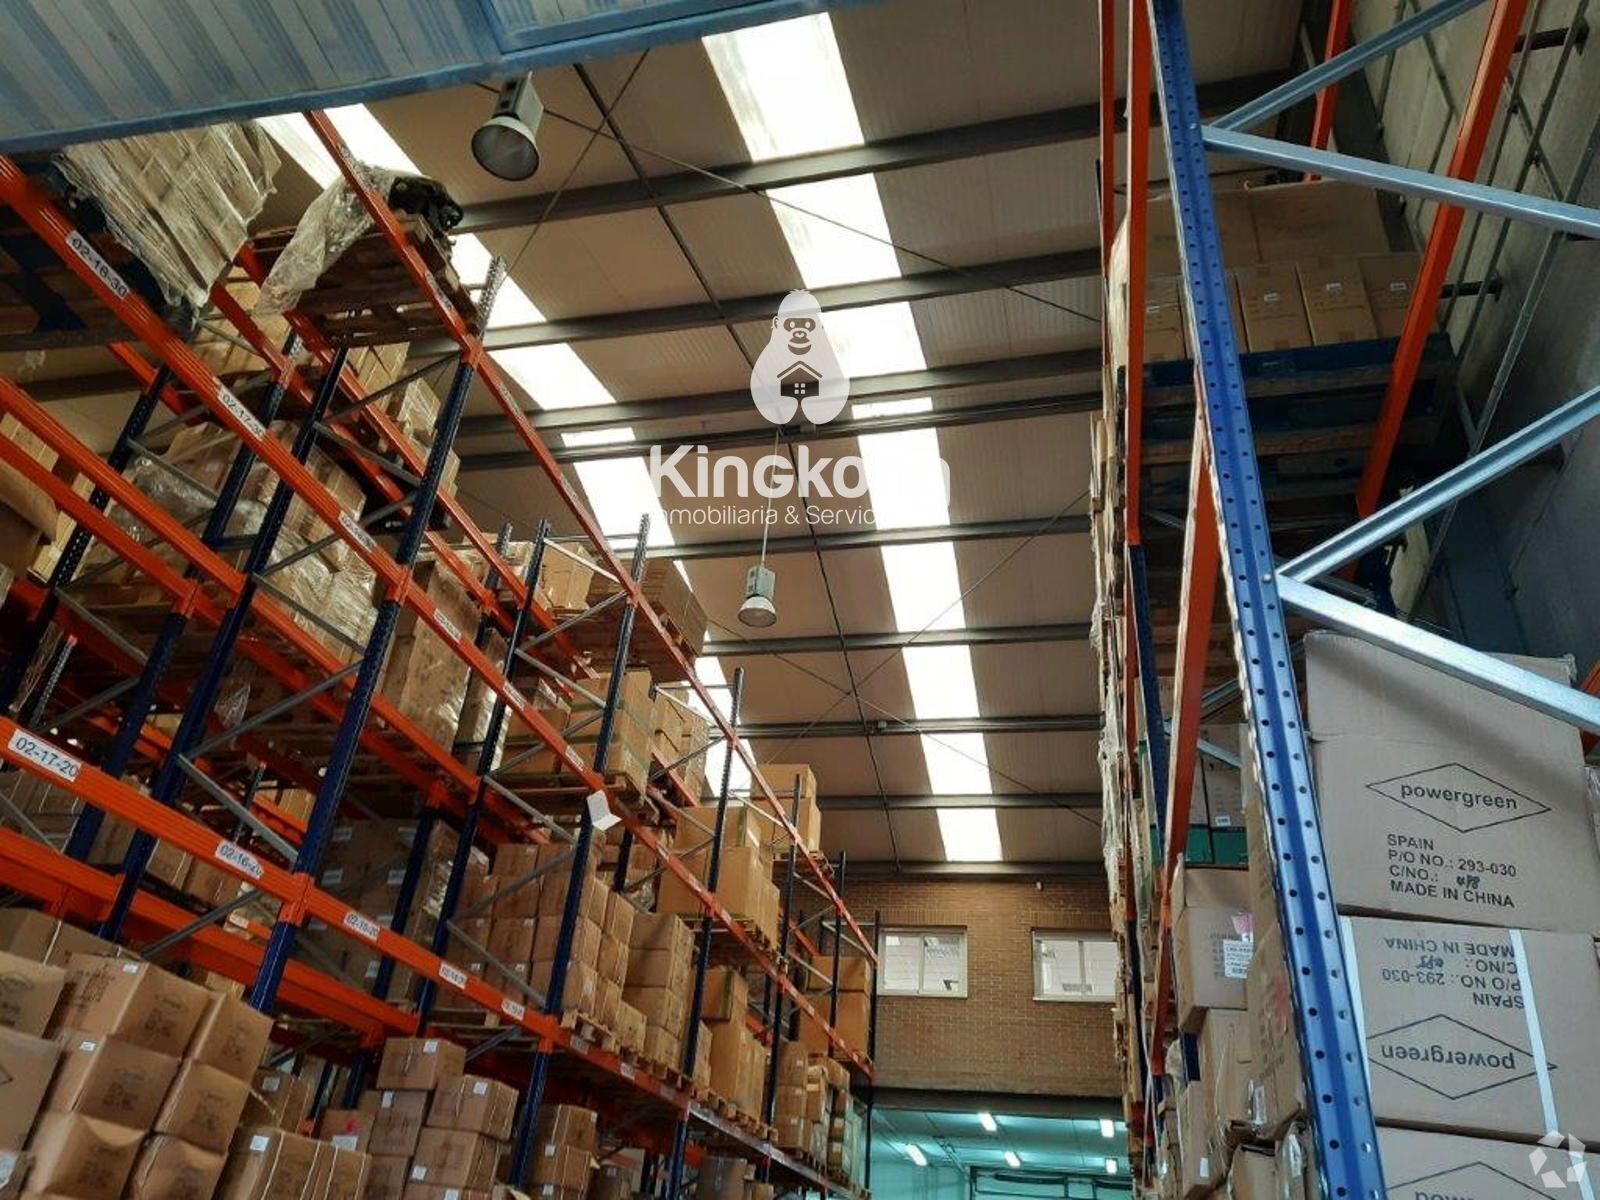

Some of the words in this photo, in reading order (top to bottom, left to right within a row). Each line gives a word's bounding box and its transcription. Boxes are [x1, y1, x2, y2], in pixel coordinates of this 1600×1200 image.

[15, 737, 80, 777] 02-17-20
[1401, 784, 1518, 810] powergreen
[1387, 833, 1435, 851] SPAIN
[1388, 848, 1416, 864] P/O
[1458, 858, 1517, 877] 293-030
[1390, 879, 1438, 898] MADE
[1443, 887, 1459, 901] IN
[1463, 890, 1515, 909] CHINA
[1383, 937, 1438, 952] CHINA
[1443, 941, 1460, 953] IN
[1464, 943, 1515, 958] MADE
[1382, 968, 1445, 985] 293-030
[1492, 977, 1521, 992] P/O
[1473, 992, 1525, 1009] SPAIN
[1381, 1043, 1516, 1070] powergreen
